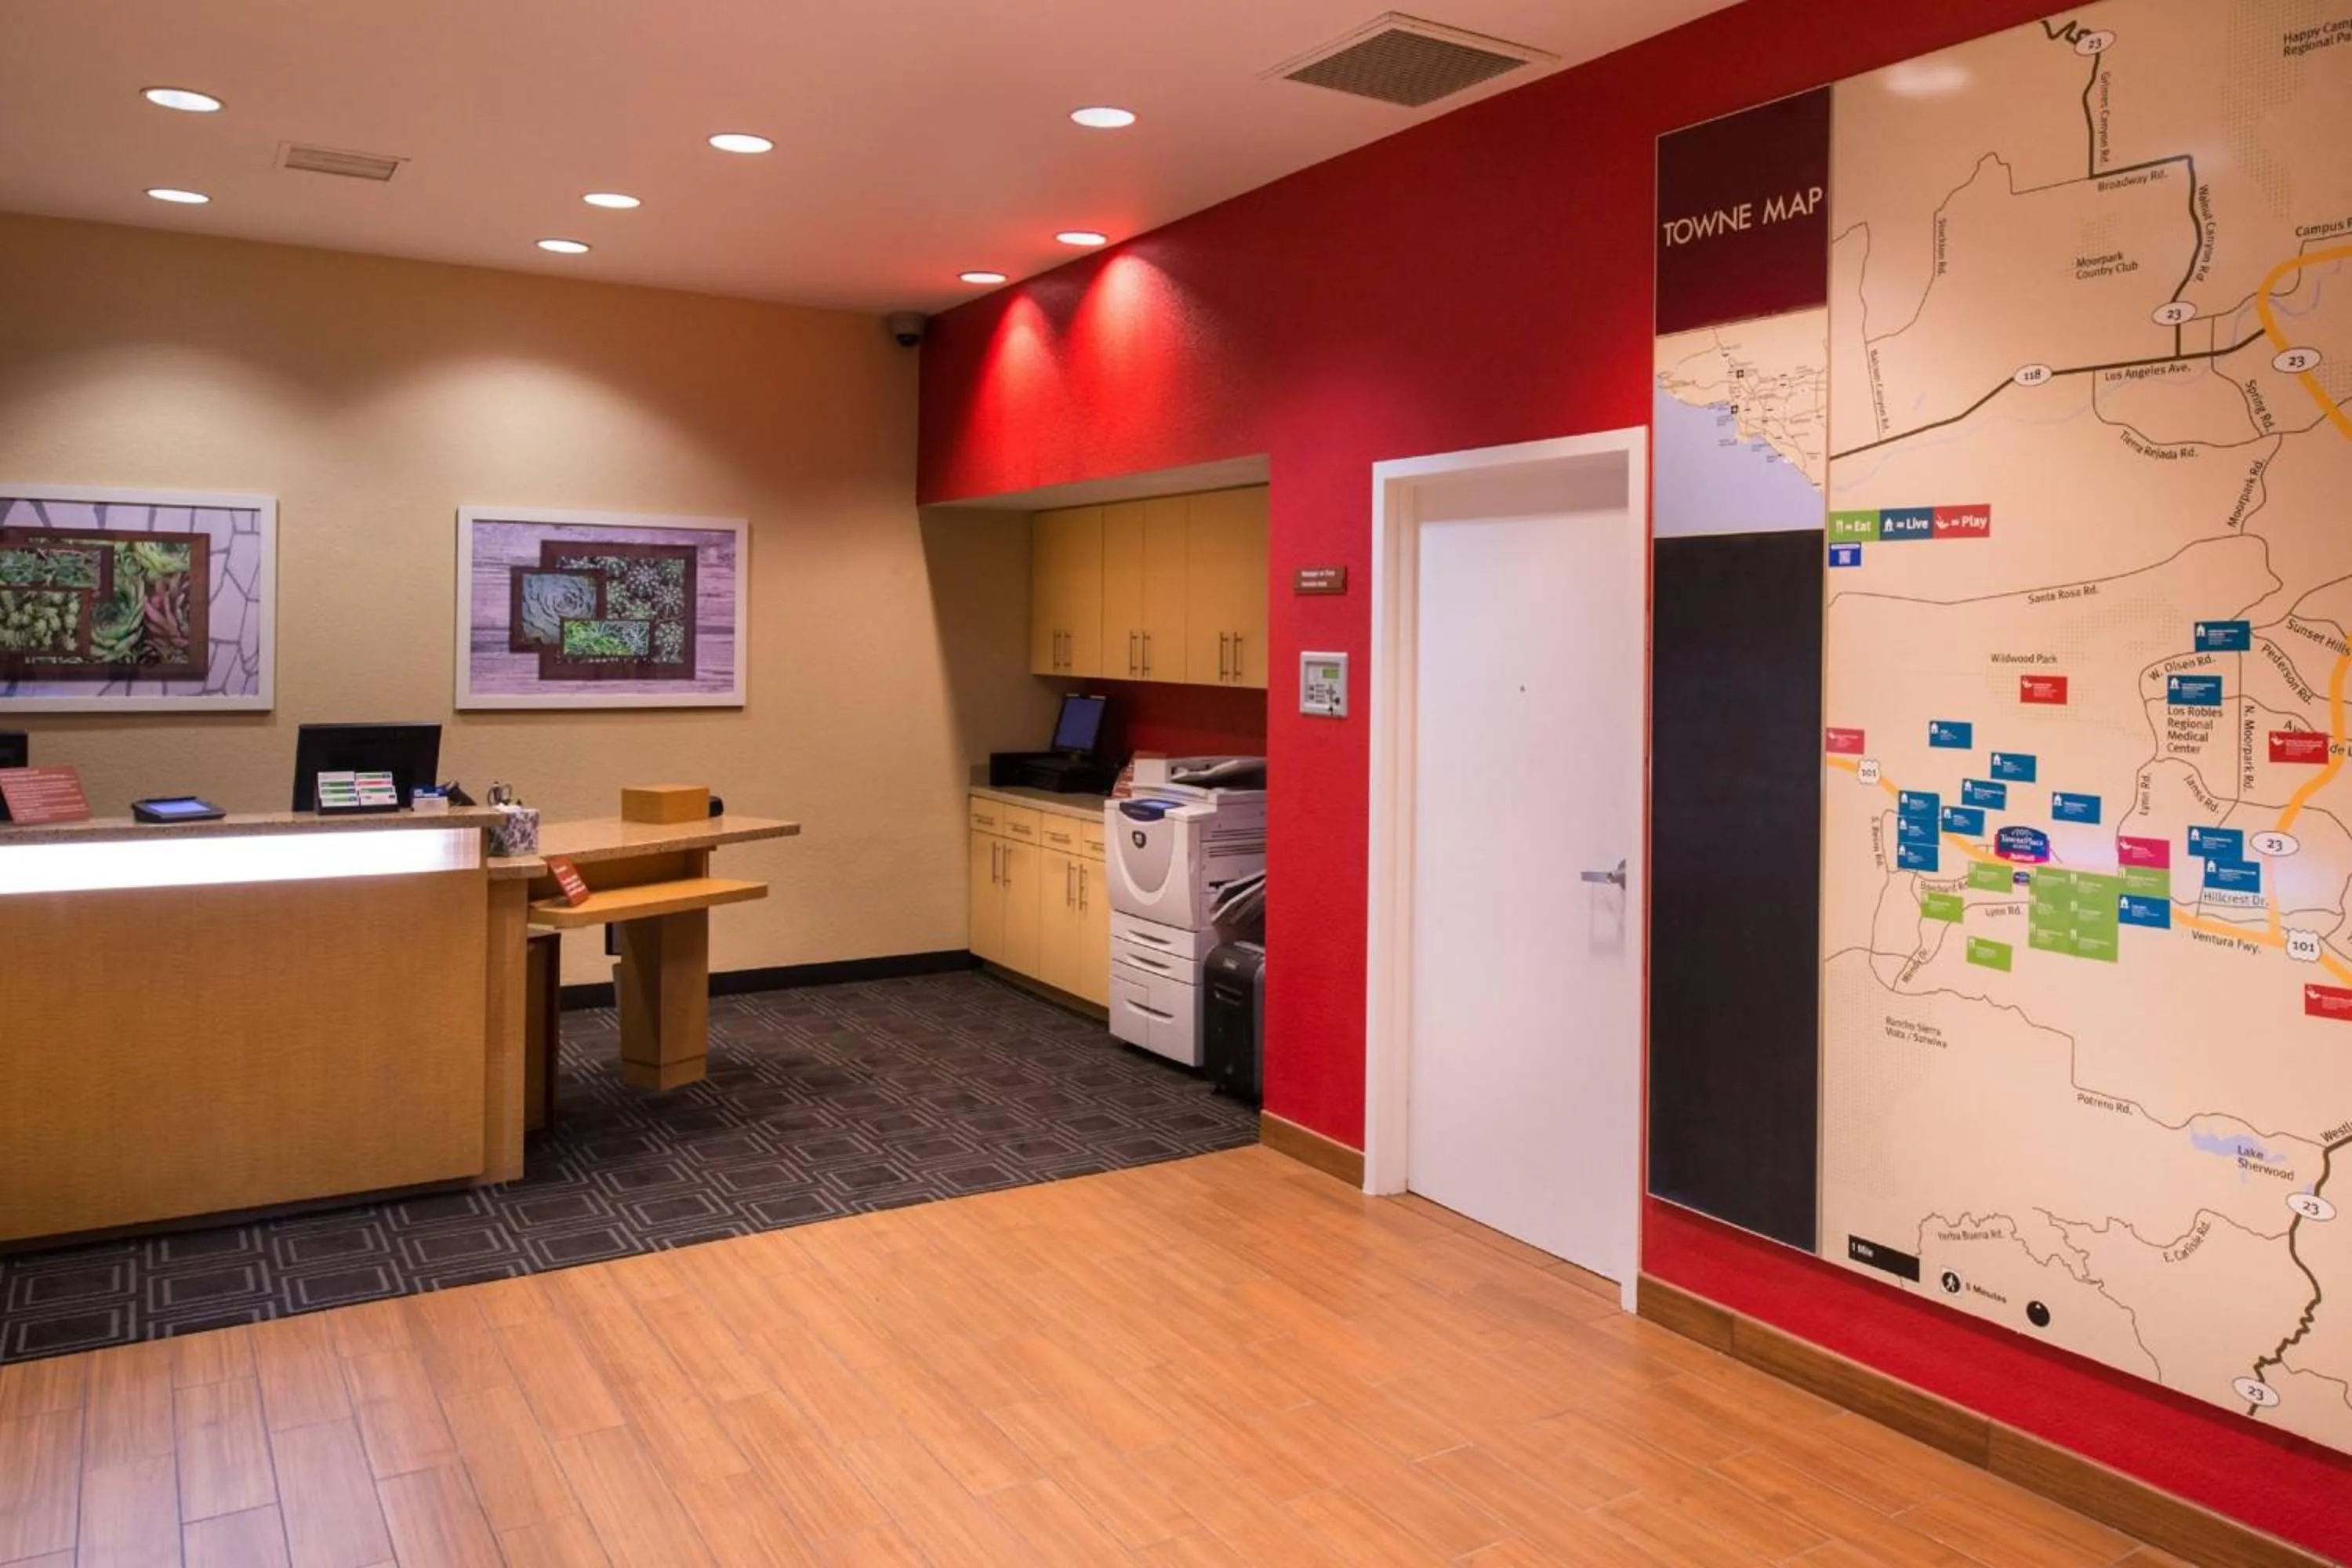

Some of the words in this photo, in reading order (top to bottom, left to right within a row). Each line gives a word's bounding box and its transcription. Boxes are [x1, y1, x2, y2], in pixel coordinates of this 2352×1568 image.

[2283, 28, 2321, 45] Happy
[2283, 34, 2334, 56] Regional
[2097, 174, 2148, 192] Broadway
[1663, 203, 1753, 247] TOWNE
[1762, 187, 1823, 225] MAP
[2295, 220, 2345, 238] Campus
[2076, 252, 2123, 268] Moorpark
[2075, 264, 2114, 280] Country
[2116, 261, 2139, 274] Club
[2167, 309, 2182, 320] 23
[2288, 355, 2305, 367] 23
[2024, 369, 2042, 381] 118
[2105, 370, 2122, 381] Los
[2124, 365, 2165, 381] Angeles
[2168, 364, 2191, 374] Ave.
[2245, 379, 2266, 413] Spring
[2227, 475, 2256, 528] Moorpark
[1854, 521, 1871, 532] Eat
[1907, 517, 1929, 529] Live
[1962, 515, 1987, 529] Play
[2027, 591, 2054, 604] Santa
[2057, 588, 2080, 601] Rosa
[2285, 619, 2325, 643] Sunset
[2325, 637, 2351, 656] Hills
[1991, 654, 2035, 664] Wildwood
[2037, 654, 2057, 663] Park
[2260, 644, 2300, 694] Pederson
[2167, 706, 2184, 716] Los
[2187, 706, 2223, 717] Robles
[2167, 718, 2213, 731] Regional
[2167, 730, 2209, 742] Medical
[2167, 743, 2201, 754] Center
[2244, 720, 2254, 773] Moorpark
[2267, 839, 2283, 852] 23
[2203, 891, 2249, 905] Hillcrest
[2252, 894, 2269, 906] Dr.
[2191, 929, 2234, 948] Ventura
[2237, 938, 2261, 954] Fwy.
[2292, 941, 2314, 953] 101
[2238, 1145, 2264, 1160] Lake
[2238, 1157, 2294, 1181] Sherwood
[2303, 1201, 2319, 1215] 23
[2248, 1385, 2264, 1401] 23
